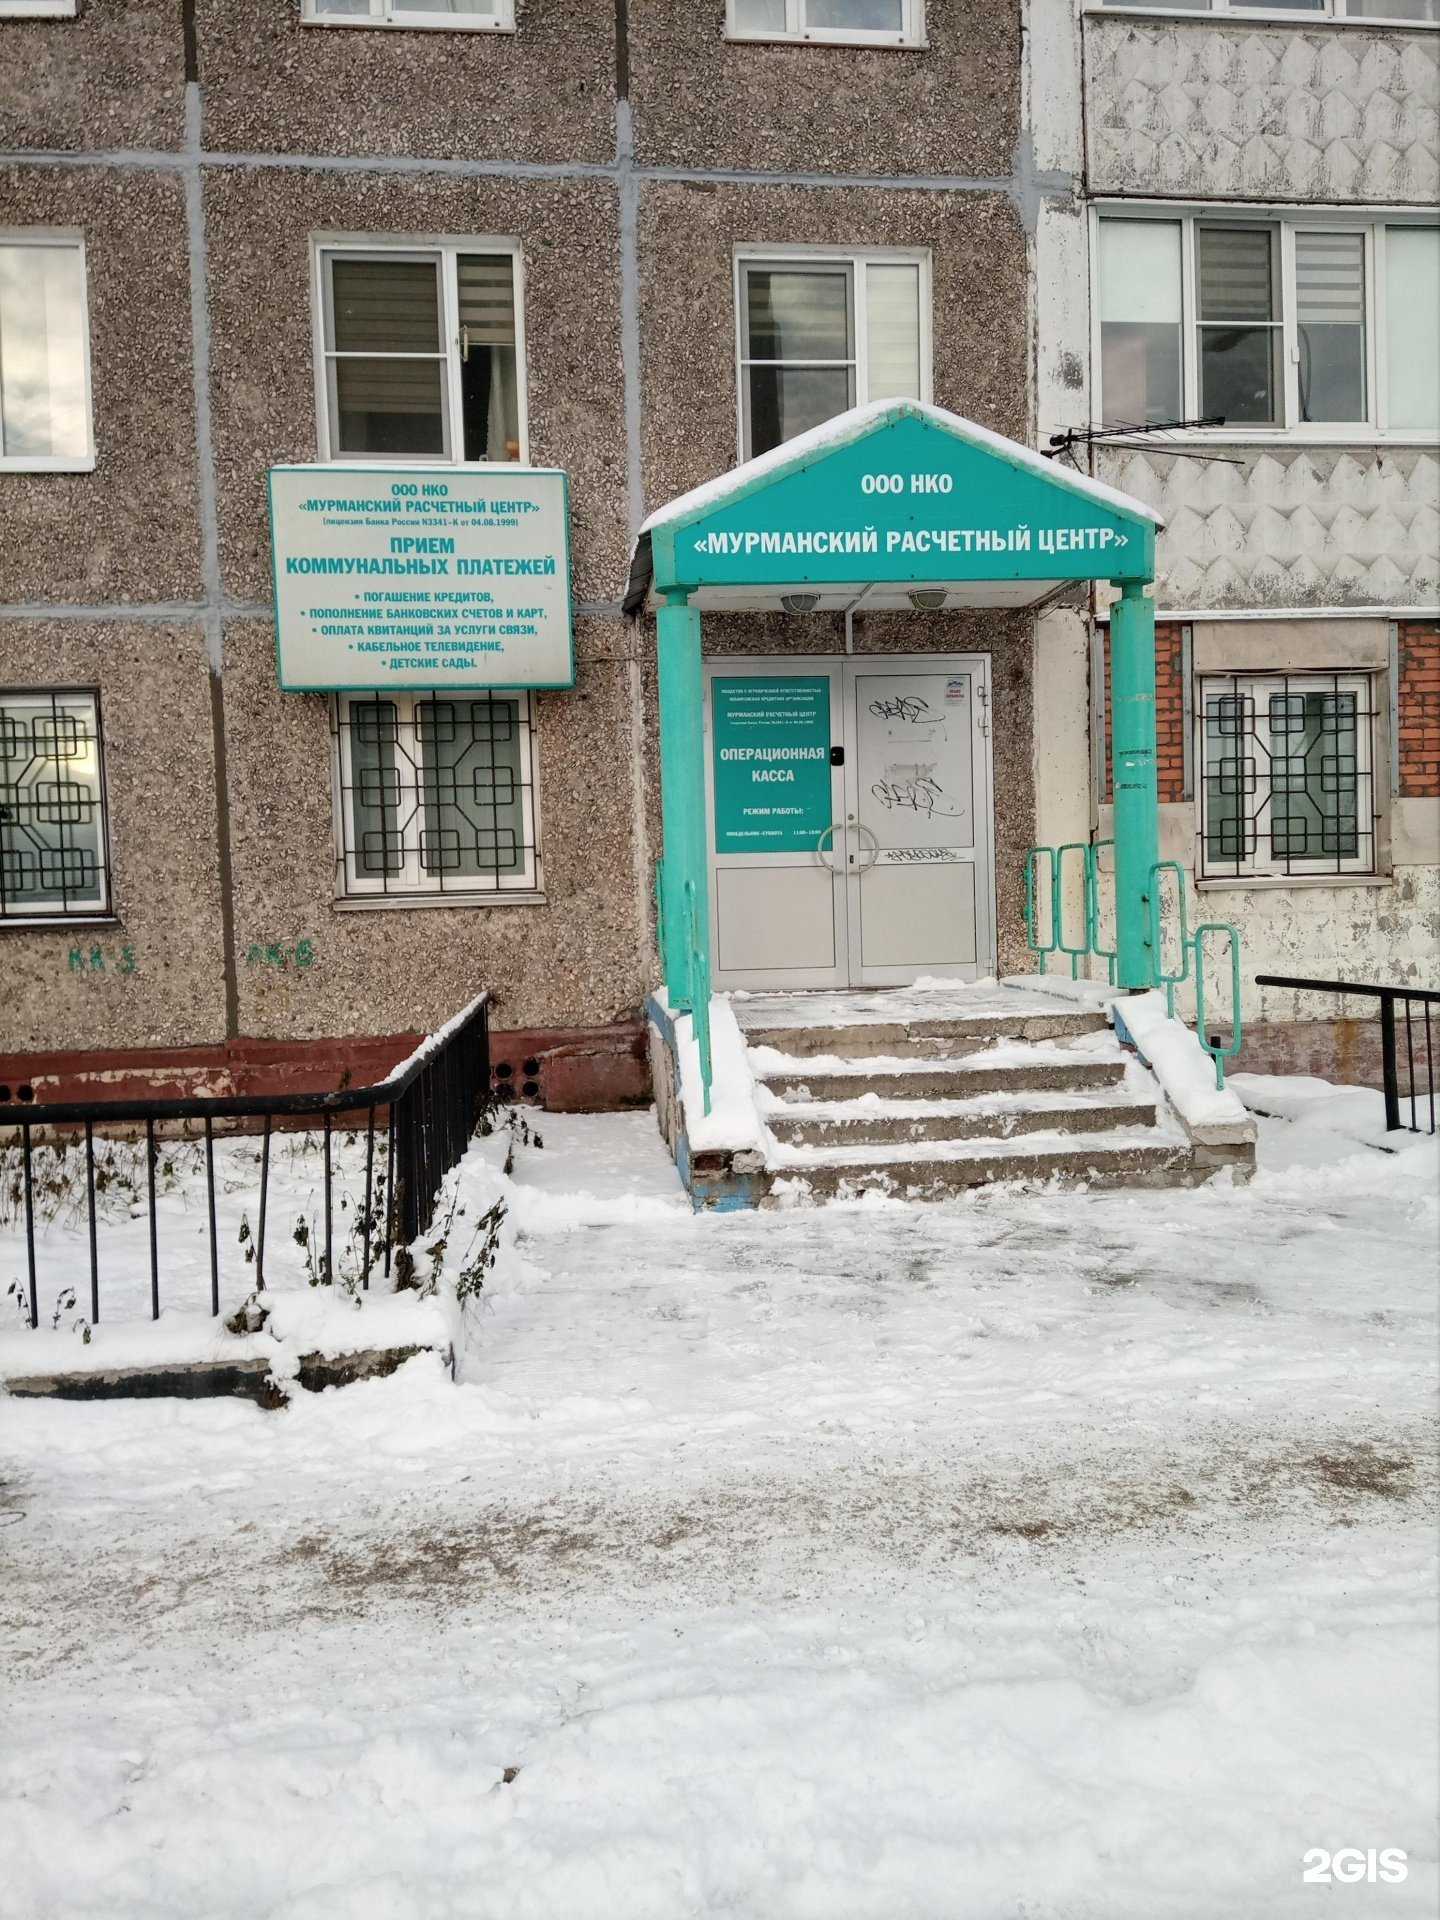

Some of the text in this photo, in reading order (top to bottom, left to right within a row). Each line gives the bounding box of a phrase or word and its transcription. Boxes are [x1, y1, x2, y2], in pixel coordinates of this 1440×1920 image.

[391, 484, 448, 496] ООО НКО
[861, 474, 953, 494] ООО НКО
[298, 498, 540, 515] «МУРМАНСКИЙ РАСЧЕТНЫЙ ЦЕНТР»
[391, 518, 420, 526] России
[390, 537, 455, 554] ПРИЕМ
[693, 525, 1128, 555] «МУРМАНСКИЙ РАСЧЕТНЫЙ ЦЕНТР»
[286, 555, 556, 576] КОММУНАЛЬНЫХ ПЛАТЕЖЕЙ
[363, 592, 494, 603] ПОГАШЕНИЕ КРЕДИТОВ,
[309, 608, 547, 620] ПОПОЛНЕНИЕ БАНКОВСКИХ СЧЕТОВ И КАРТ,
[320, 623, 538, 637] ОПЛАТА КВИТАНЦИЙ ЗА УСЛУГИ СВЯЗИ,
[357, 641, 504, 653] КАБЕЛЬНОЕ ТЕЛЕВИДЕНИЕ,
[389, 658, 478, 670] ДЕТСКИЕ САДЫ.
[720, 747, 825, 762] ОПЕРАЦИОННАЯ
[752, 769, 794, 782] КАССА
